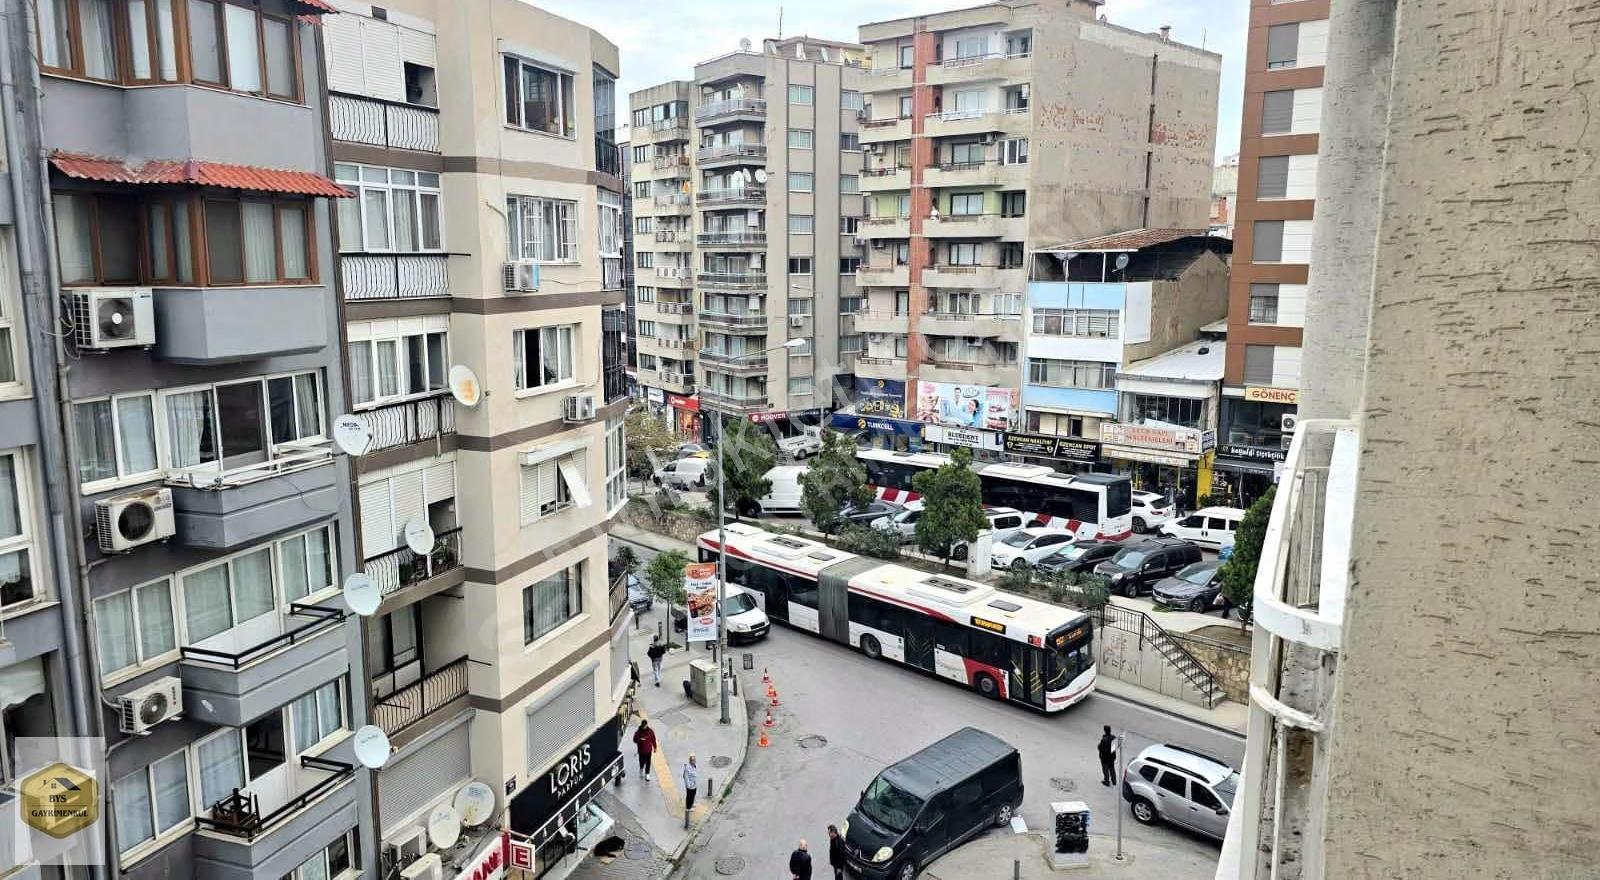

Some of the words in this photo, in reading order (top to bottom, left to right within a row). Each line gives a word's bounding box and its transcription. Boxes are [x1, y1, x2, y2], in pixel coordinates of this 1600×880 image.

[1252, 389, 1296, 403] GÖNENÇ
[761, 413, 786, 421] HOOVER
[550, 744, 590, 794] LORIS
[515, 847, 529, 866] E
